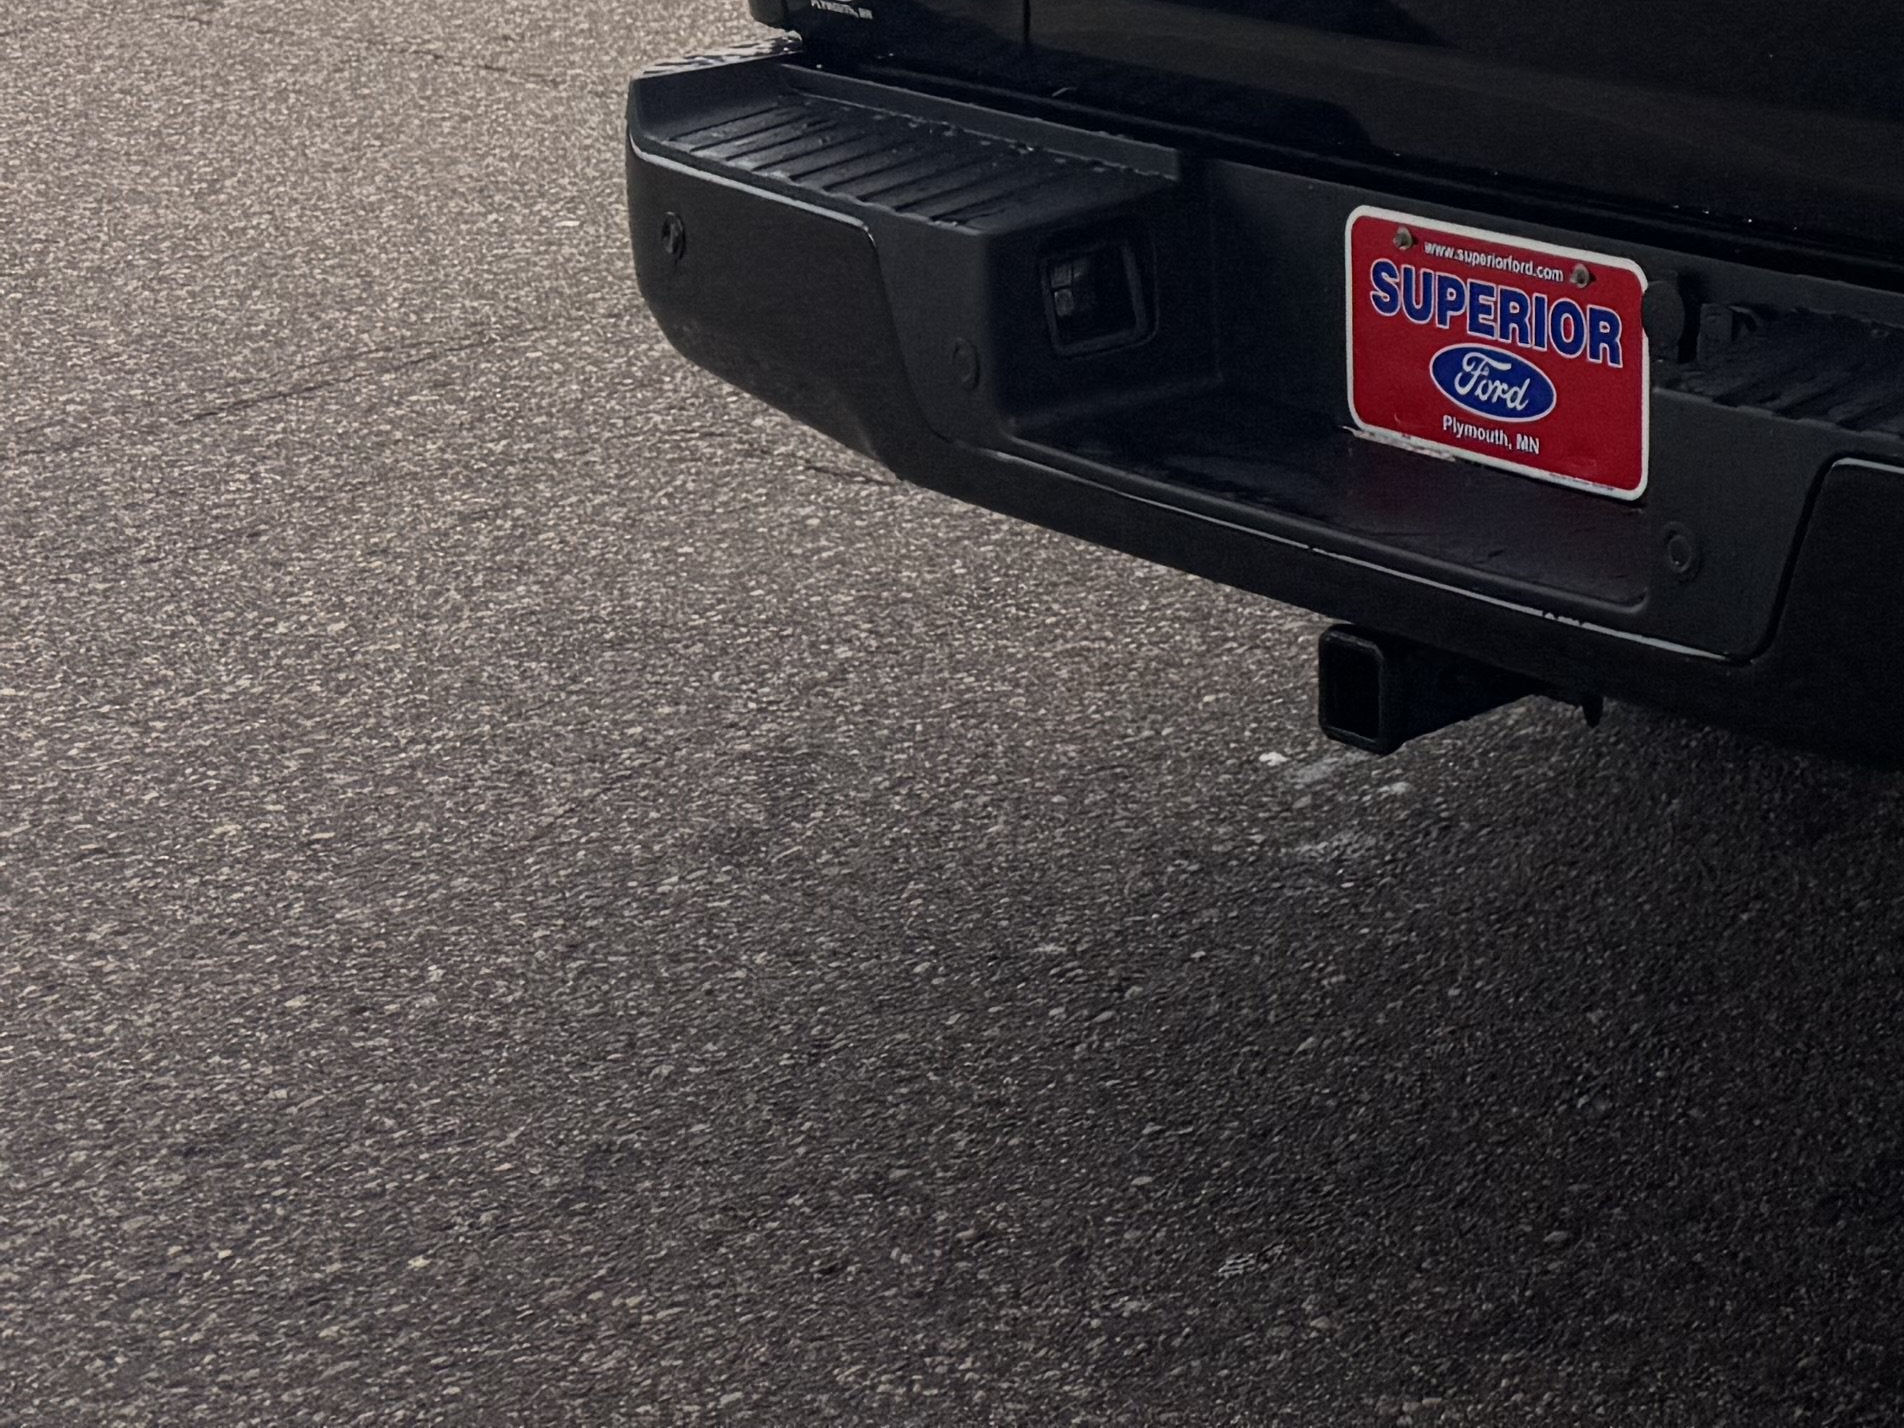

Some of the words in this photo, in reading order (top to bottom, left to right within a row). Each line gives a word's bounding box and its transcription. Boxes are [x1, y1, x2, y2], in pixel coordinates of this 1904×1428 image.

[1423, 240, 1564, 283] www.superiorford.com
[1369, 257, 1624, 369] SUPERIOR
[1453, 351, 1531, 411] Ford
[1442, 414, 1512, 450] Plymouth,
[1515, 435, 1540, 455] MN
